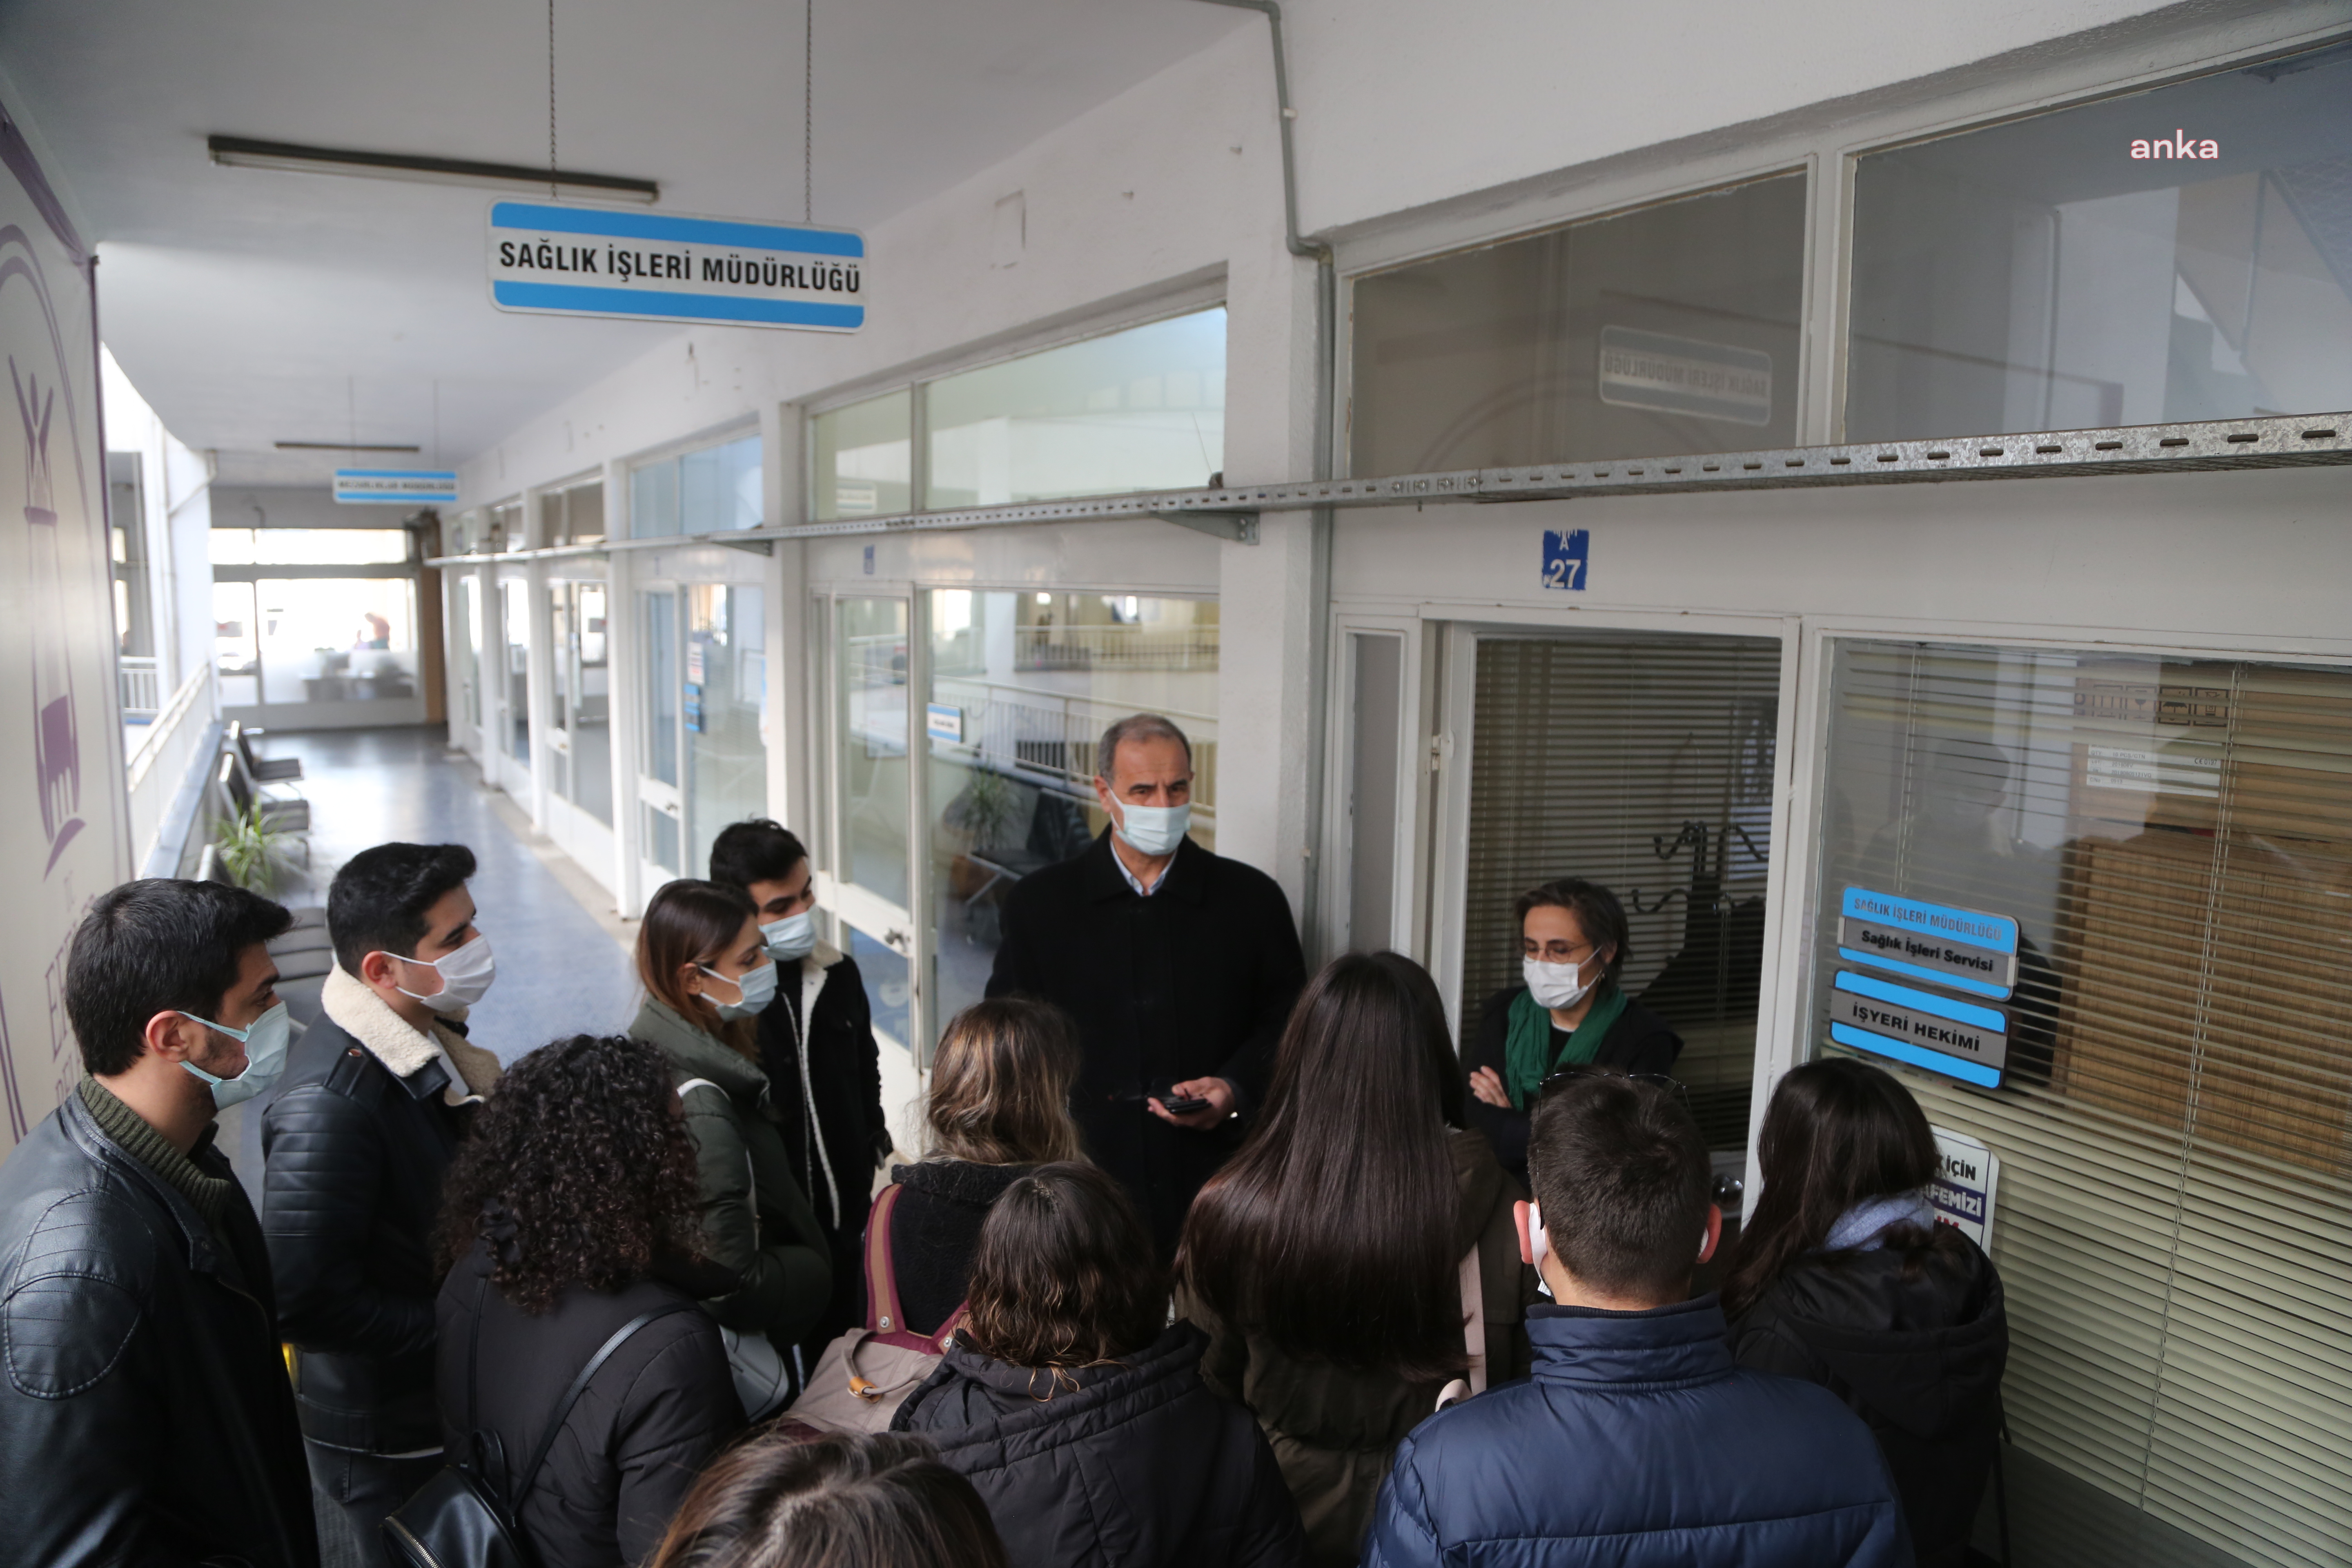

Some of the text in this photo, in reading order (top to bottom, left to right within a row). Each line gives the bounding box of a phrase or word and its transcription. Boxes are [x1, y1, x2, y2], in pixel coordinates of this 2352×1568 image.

[500, 238, 860, 293] SAĞLIK İŞLERİ MÜDÜRLÜĞÜ
[1550, 559, 1581, 588] 27
[1854, 898, 2002, 941] SAĞLIK İŞLERİ MÜDÜRLÜĞÜ
[1861, 930, 1993, 972] Sağlık İşleri Servisi
[1853, 1001, 1980, 1052] İŞYERİ HEKİMİ
[1946, 1155, 1976, 1181] İÇİN
